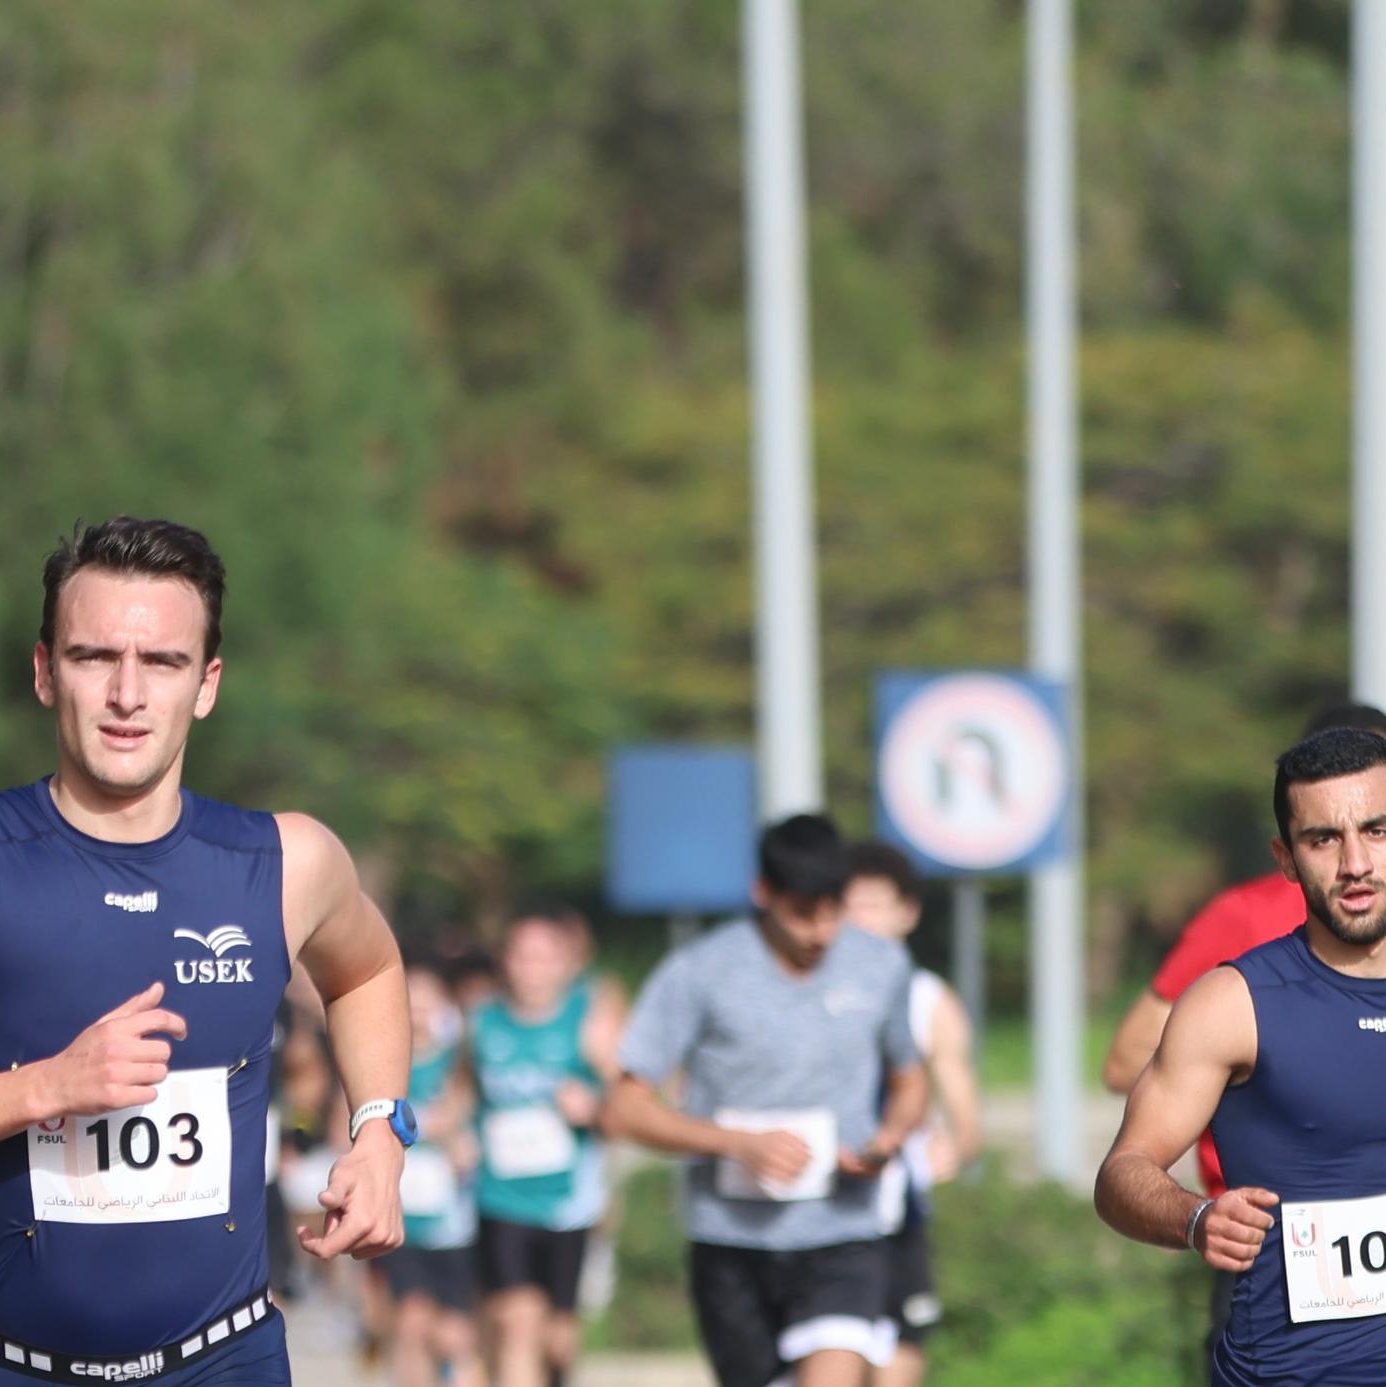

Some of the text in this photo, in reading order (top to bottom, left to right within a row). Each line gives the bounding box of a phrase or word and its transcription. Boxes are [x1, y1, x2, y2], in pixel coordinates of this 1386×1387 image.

[105, 891, 158, 911] capelli
[174, 958, 254, 984] USEK
[37, 1135, 67, 1144] FSUL
[86, 1112, 203, 1172] 103
[1293, 1249, 1318, 1258] FSUL
[69, 1350, 165, 1381] capelli
[114, 1366, 164, 1382] SPORT
